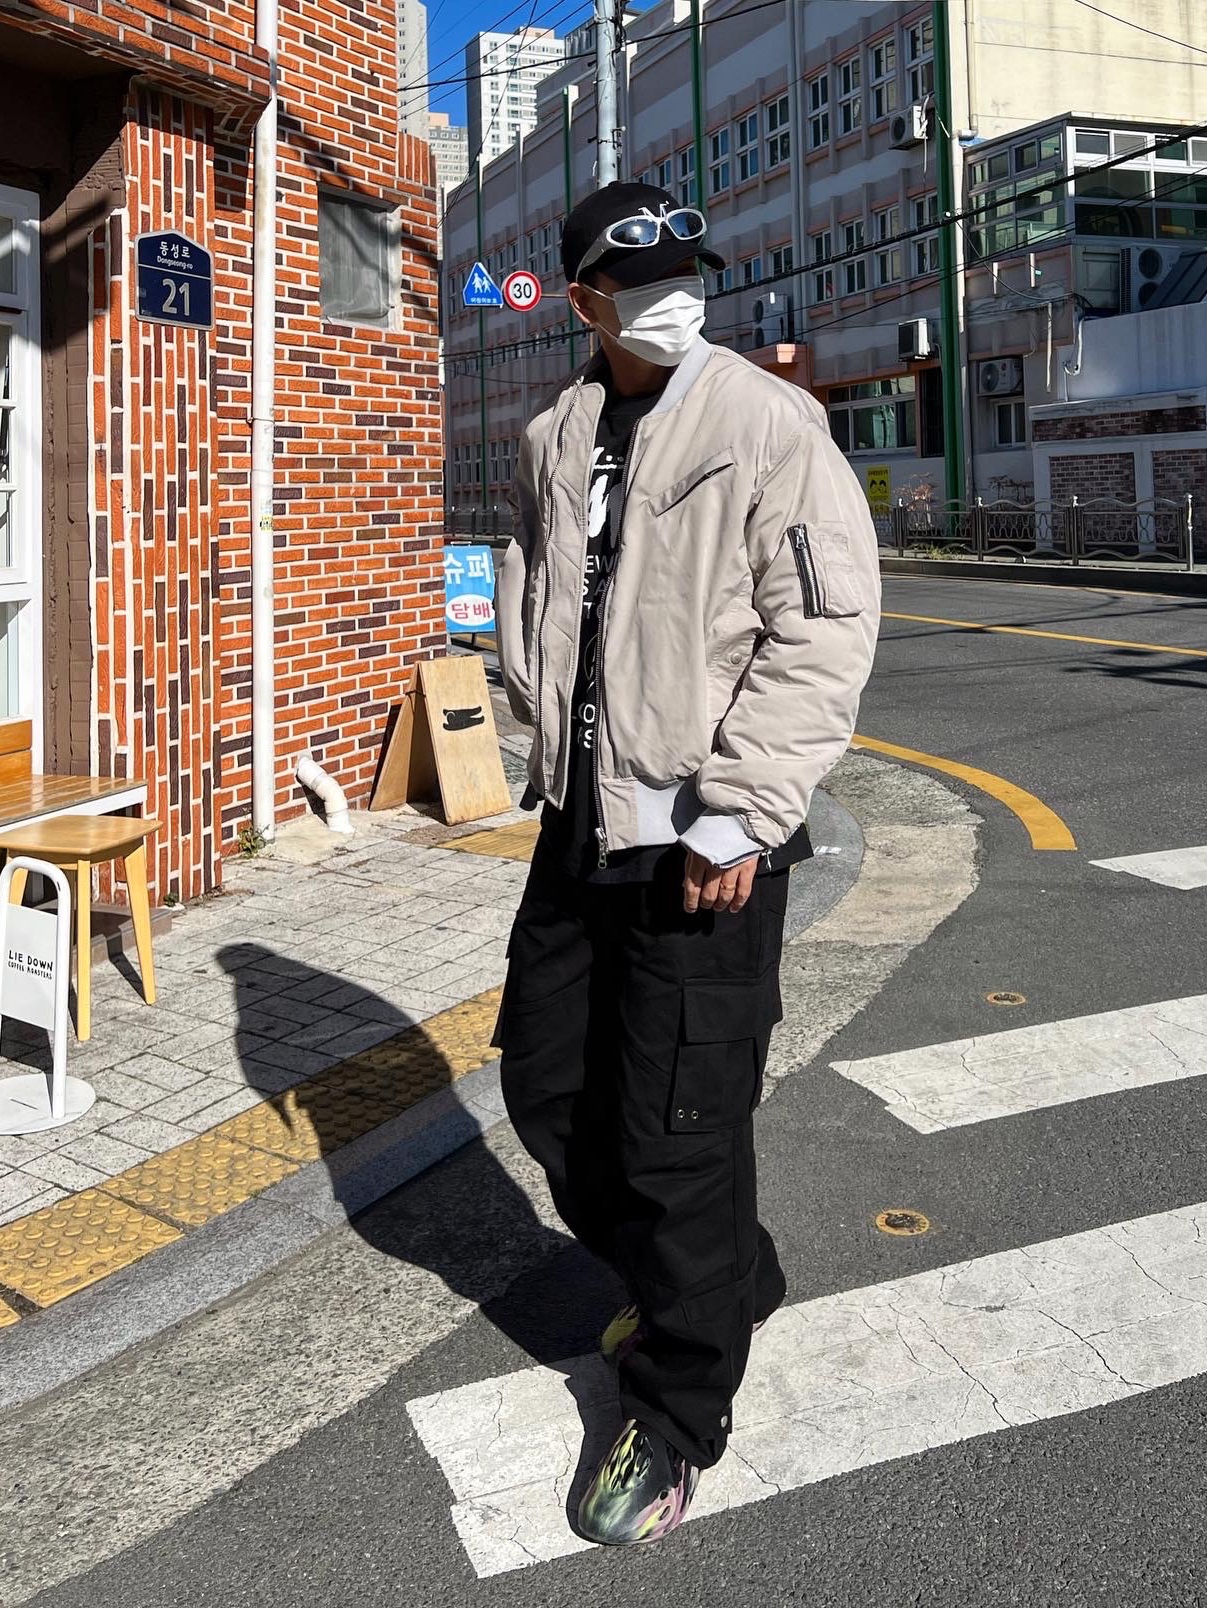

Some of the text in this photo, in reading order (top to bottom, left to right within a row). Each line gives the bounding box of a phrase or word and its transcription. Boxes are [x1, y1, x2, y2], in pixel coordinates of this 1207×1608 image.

[160, 241, 190, 258] 동성로
[157, 256, 193, 269] Dongseong-ro
[162, 278, 190, 316] 21
[513, 283, 532, 299] 30
[443, 552, 492, 585] 슈퍼
[451, 602, 490, 619] 담배
[8, 949, 53, 972] LIE DOWN
